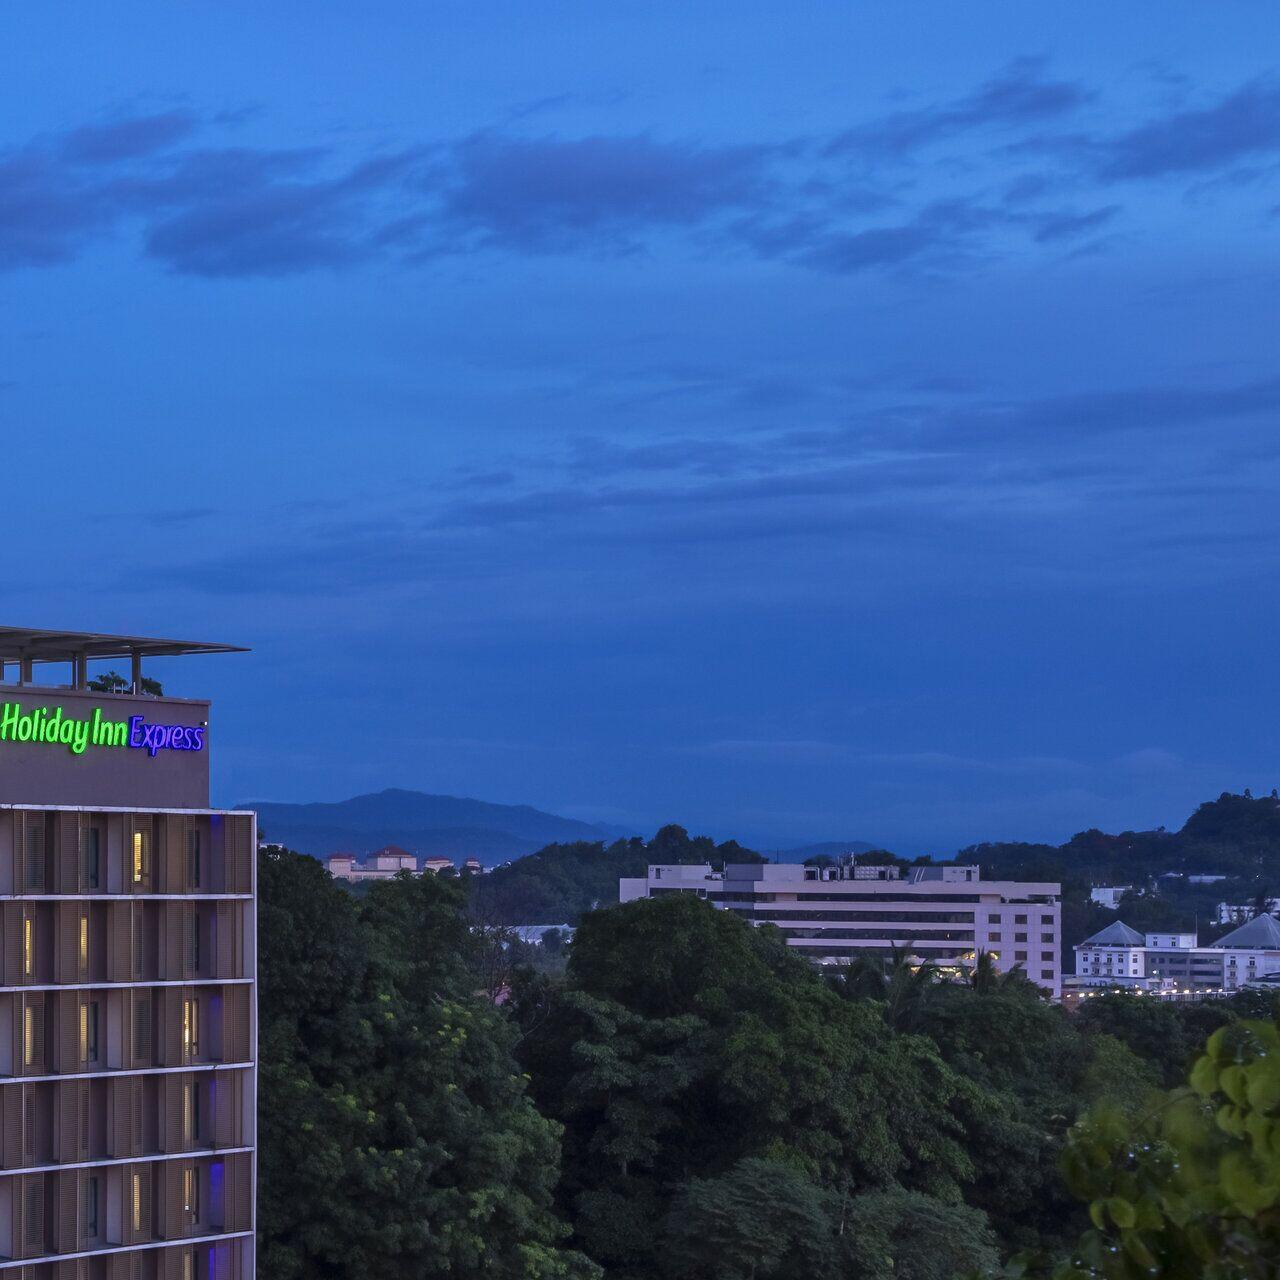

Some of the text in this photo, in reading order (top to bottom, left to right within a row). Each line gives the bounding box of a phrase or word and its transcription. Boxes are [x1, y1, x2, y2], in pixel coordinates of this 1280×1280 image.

[0, 703, 205, 757] Holiday Inn Express
